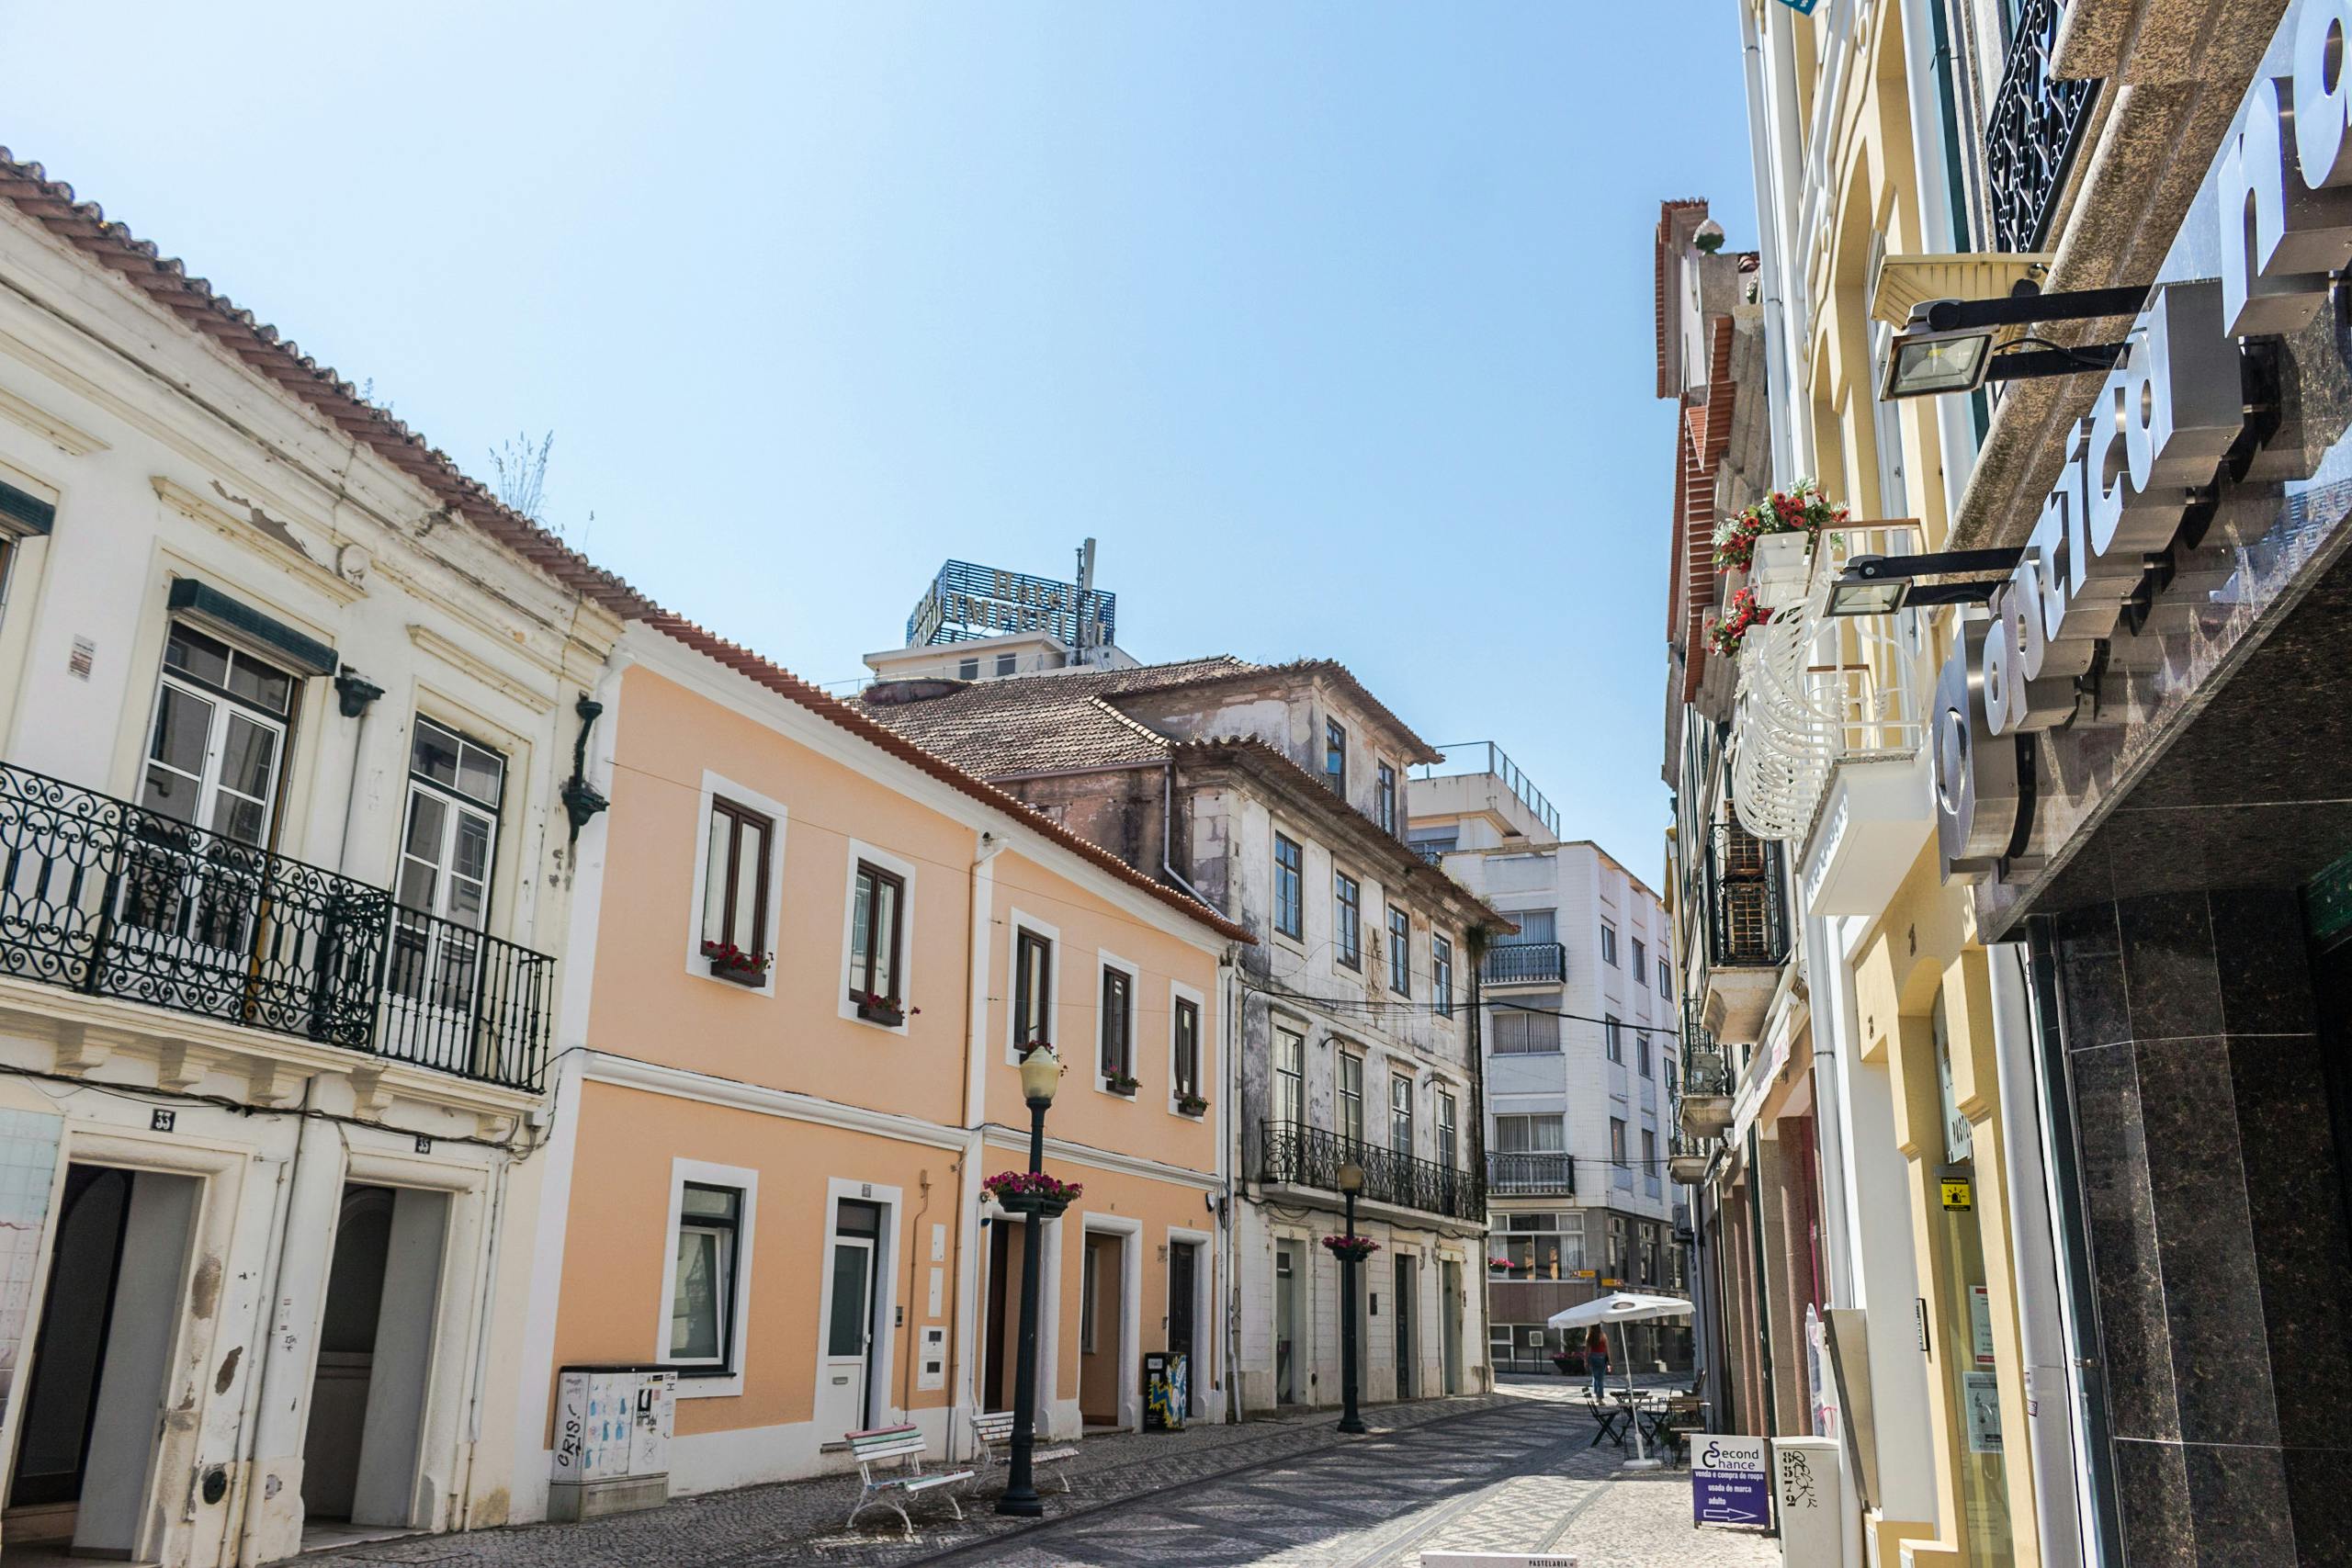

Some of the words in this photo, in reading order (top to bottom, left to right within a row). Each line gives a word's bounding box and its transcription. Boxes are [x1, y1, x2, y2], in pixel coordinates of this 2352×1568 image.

[992, 570, 1074, 613] Hotel
[155, 1111, 172, 1130] 33
[1710, 1440, 1759, 1459] Second
[1702, 1450, 1756, 1470] Chance
[1717, 1472, 1738, 1480] compra
[1747, 1473, 1764, 1482] roupa
[1735, 1485, 1752, 1494] marca
